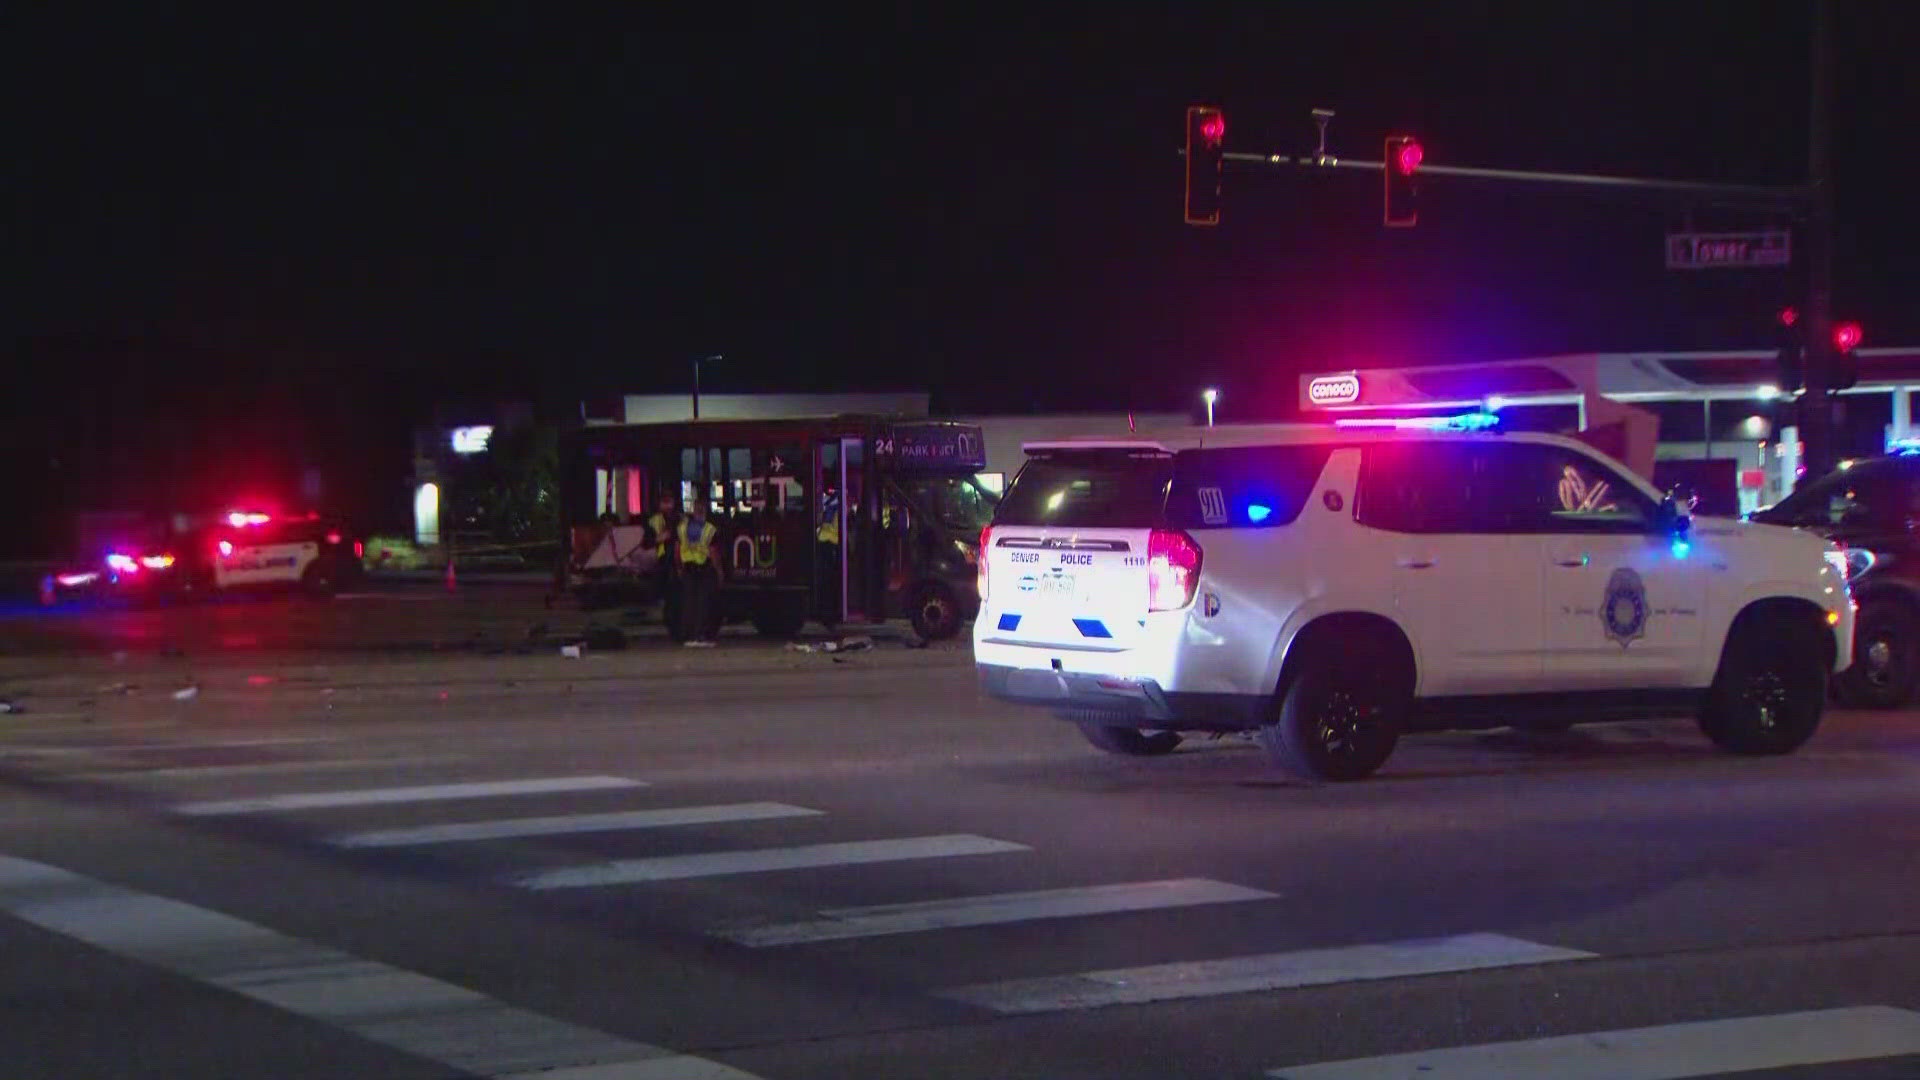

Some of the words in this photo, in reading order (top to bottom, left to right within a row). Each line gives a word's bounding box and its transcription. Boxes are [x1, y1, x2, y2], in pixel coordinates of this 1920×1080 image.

[875, 439, 894, 455] 24
[901, 444, 929, 456] PARK
[1200, 489, 1224, 516] 911
[1011, 552, 1040, 563] DENVER
[1060, 553, 1093, 565] POLICE
